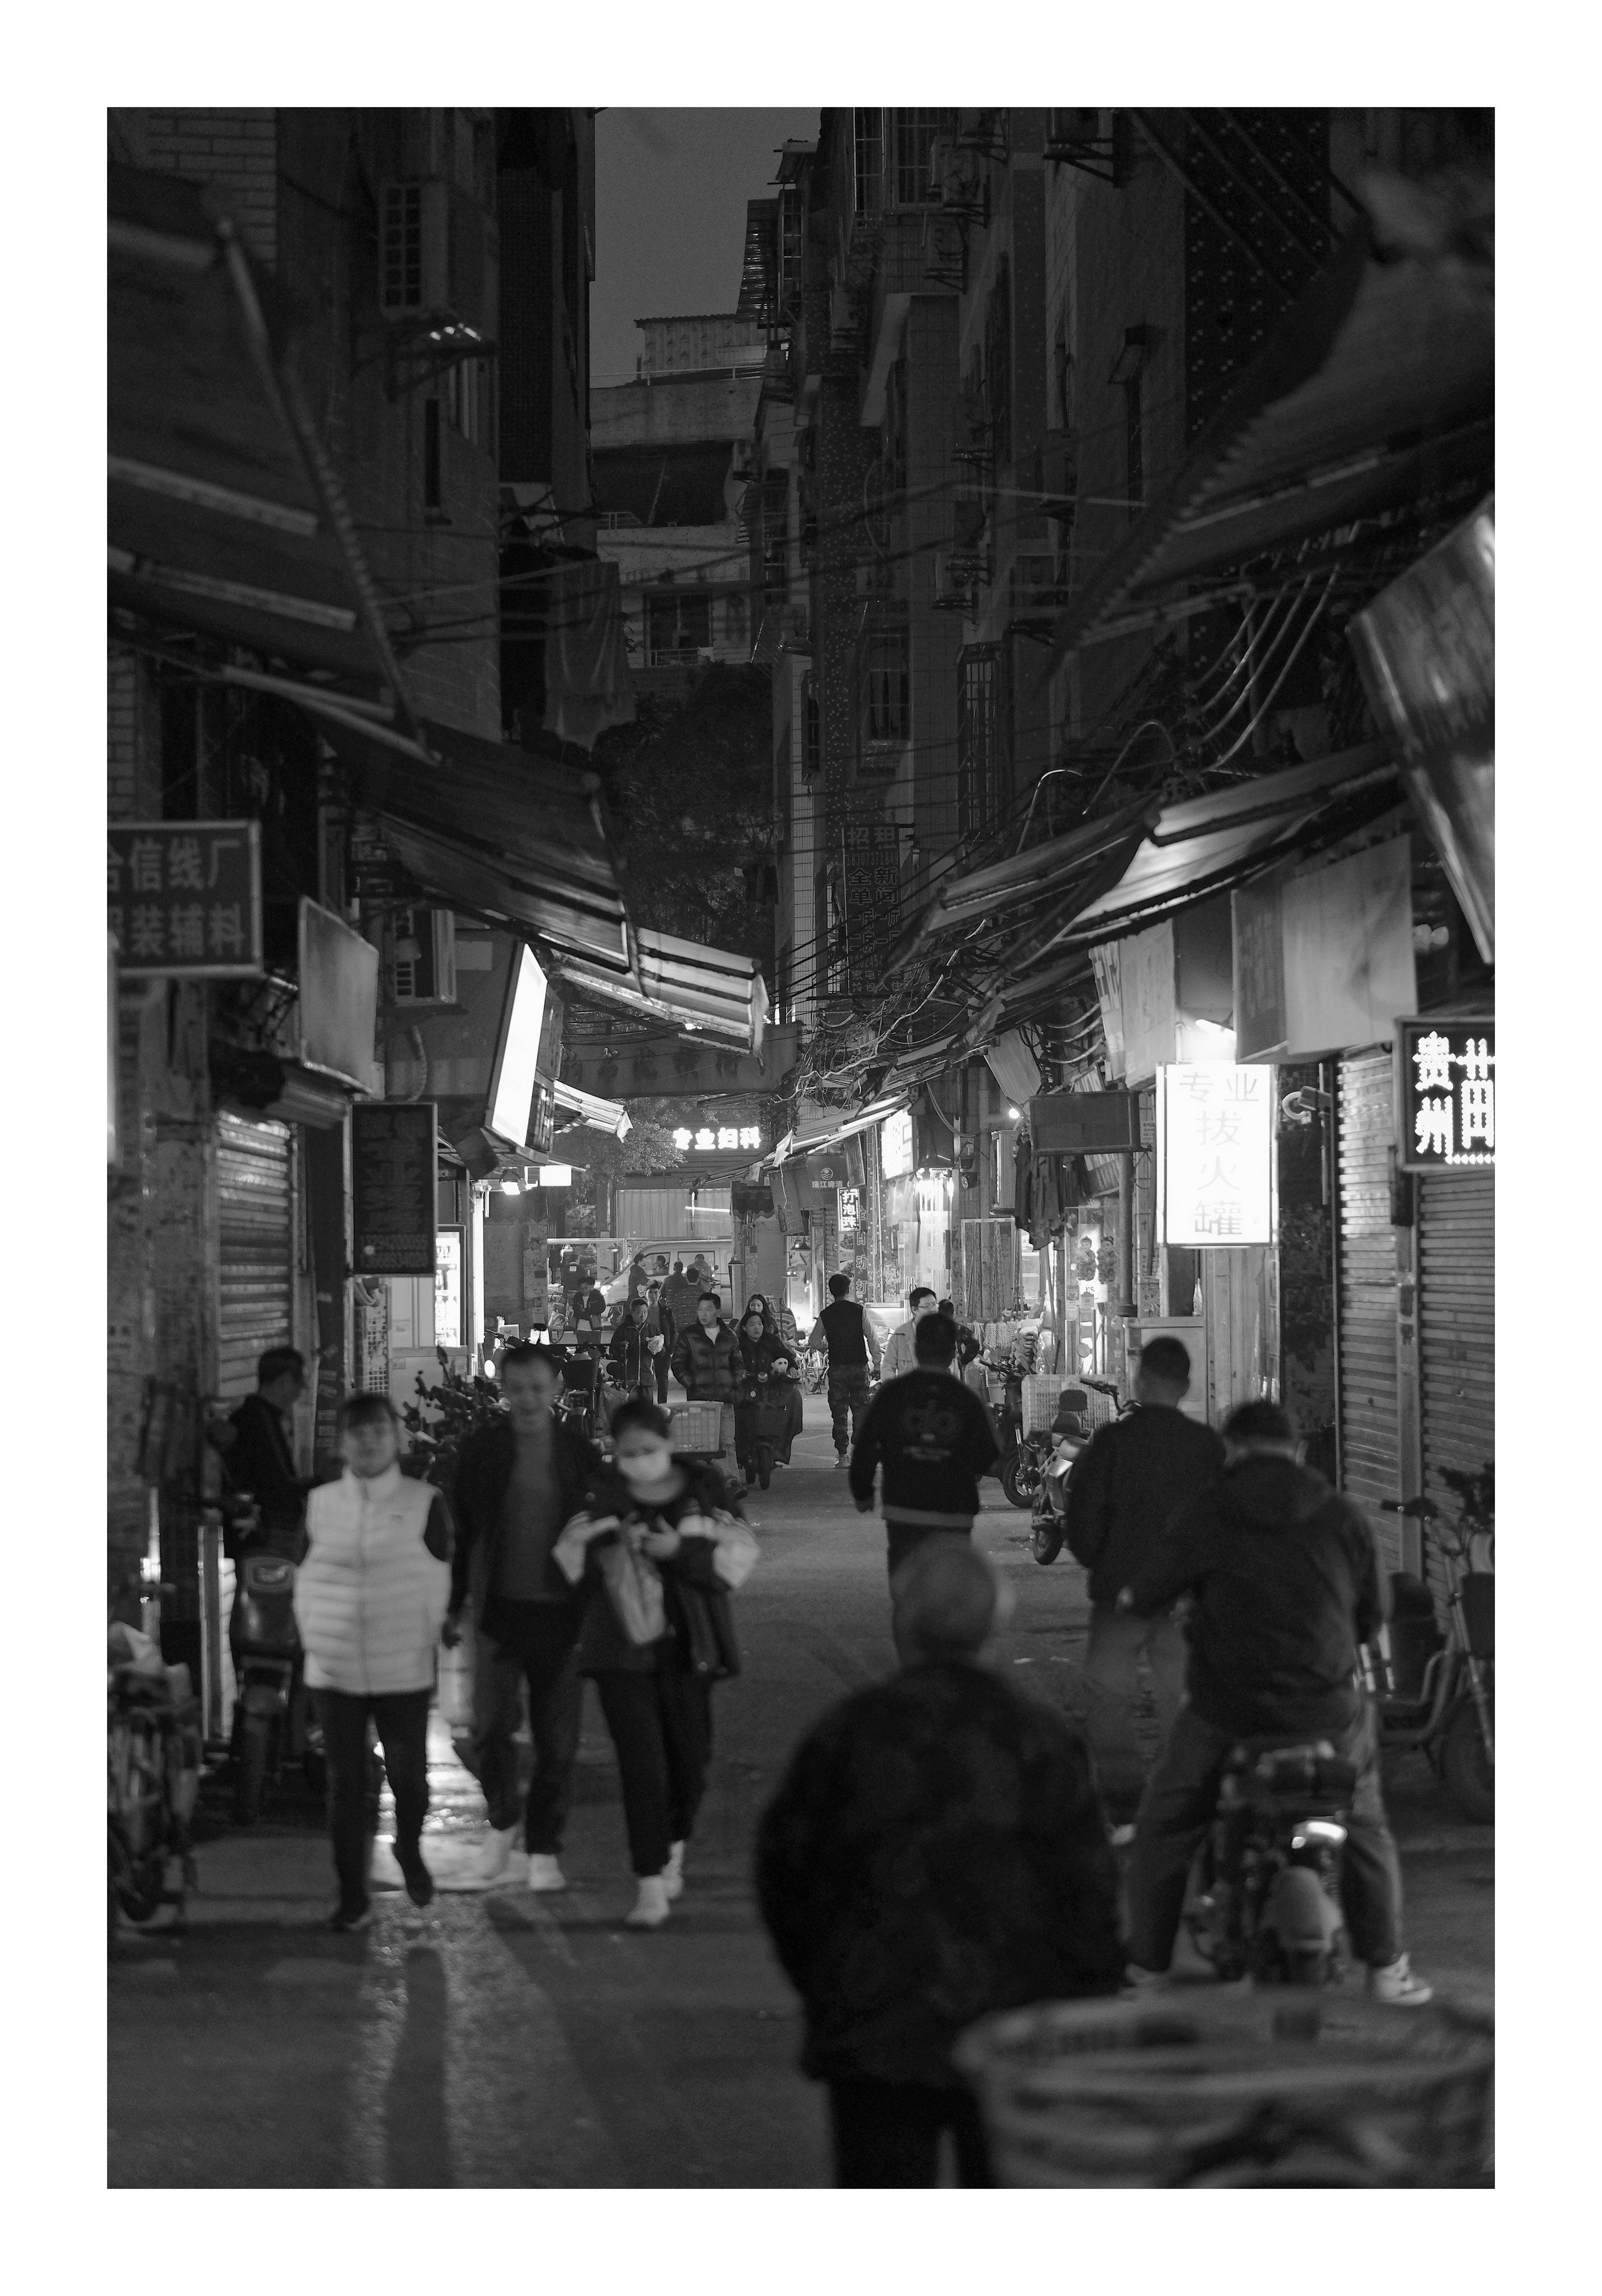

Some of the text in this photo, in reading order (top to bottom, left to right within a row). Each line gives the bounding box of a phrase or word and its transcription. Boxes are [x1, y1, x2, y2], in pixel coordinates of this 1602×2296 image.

[847, 827, 897, 850] 招租
[847, 867, 898, 885] 全新
[849, 887, 899, 906] 单间
[1179, 1071, 1258, 1103] 专业
[1412, 1031, 1456, 1155] 贵州
[673, 1126, 761, 1150] 专业妇科
[1194, 1110, 1242, 1236] 拔火罐
[856, 1205, 867, 1306] 全自动打
